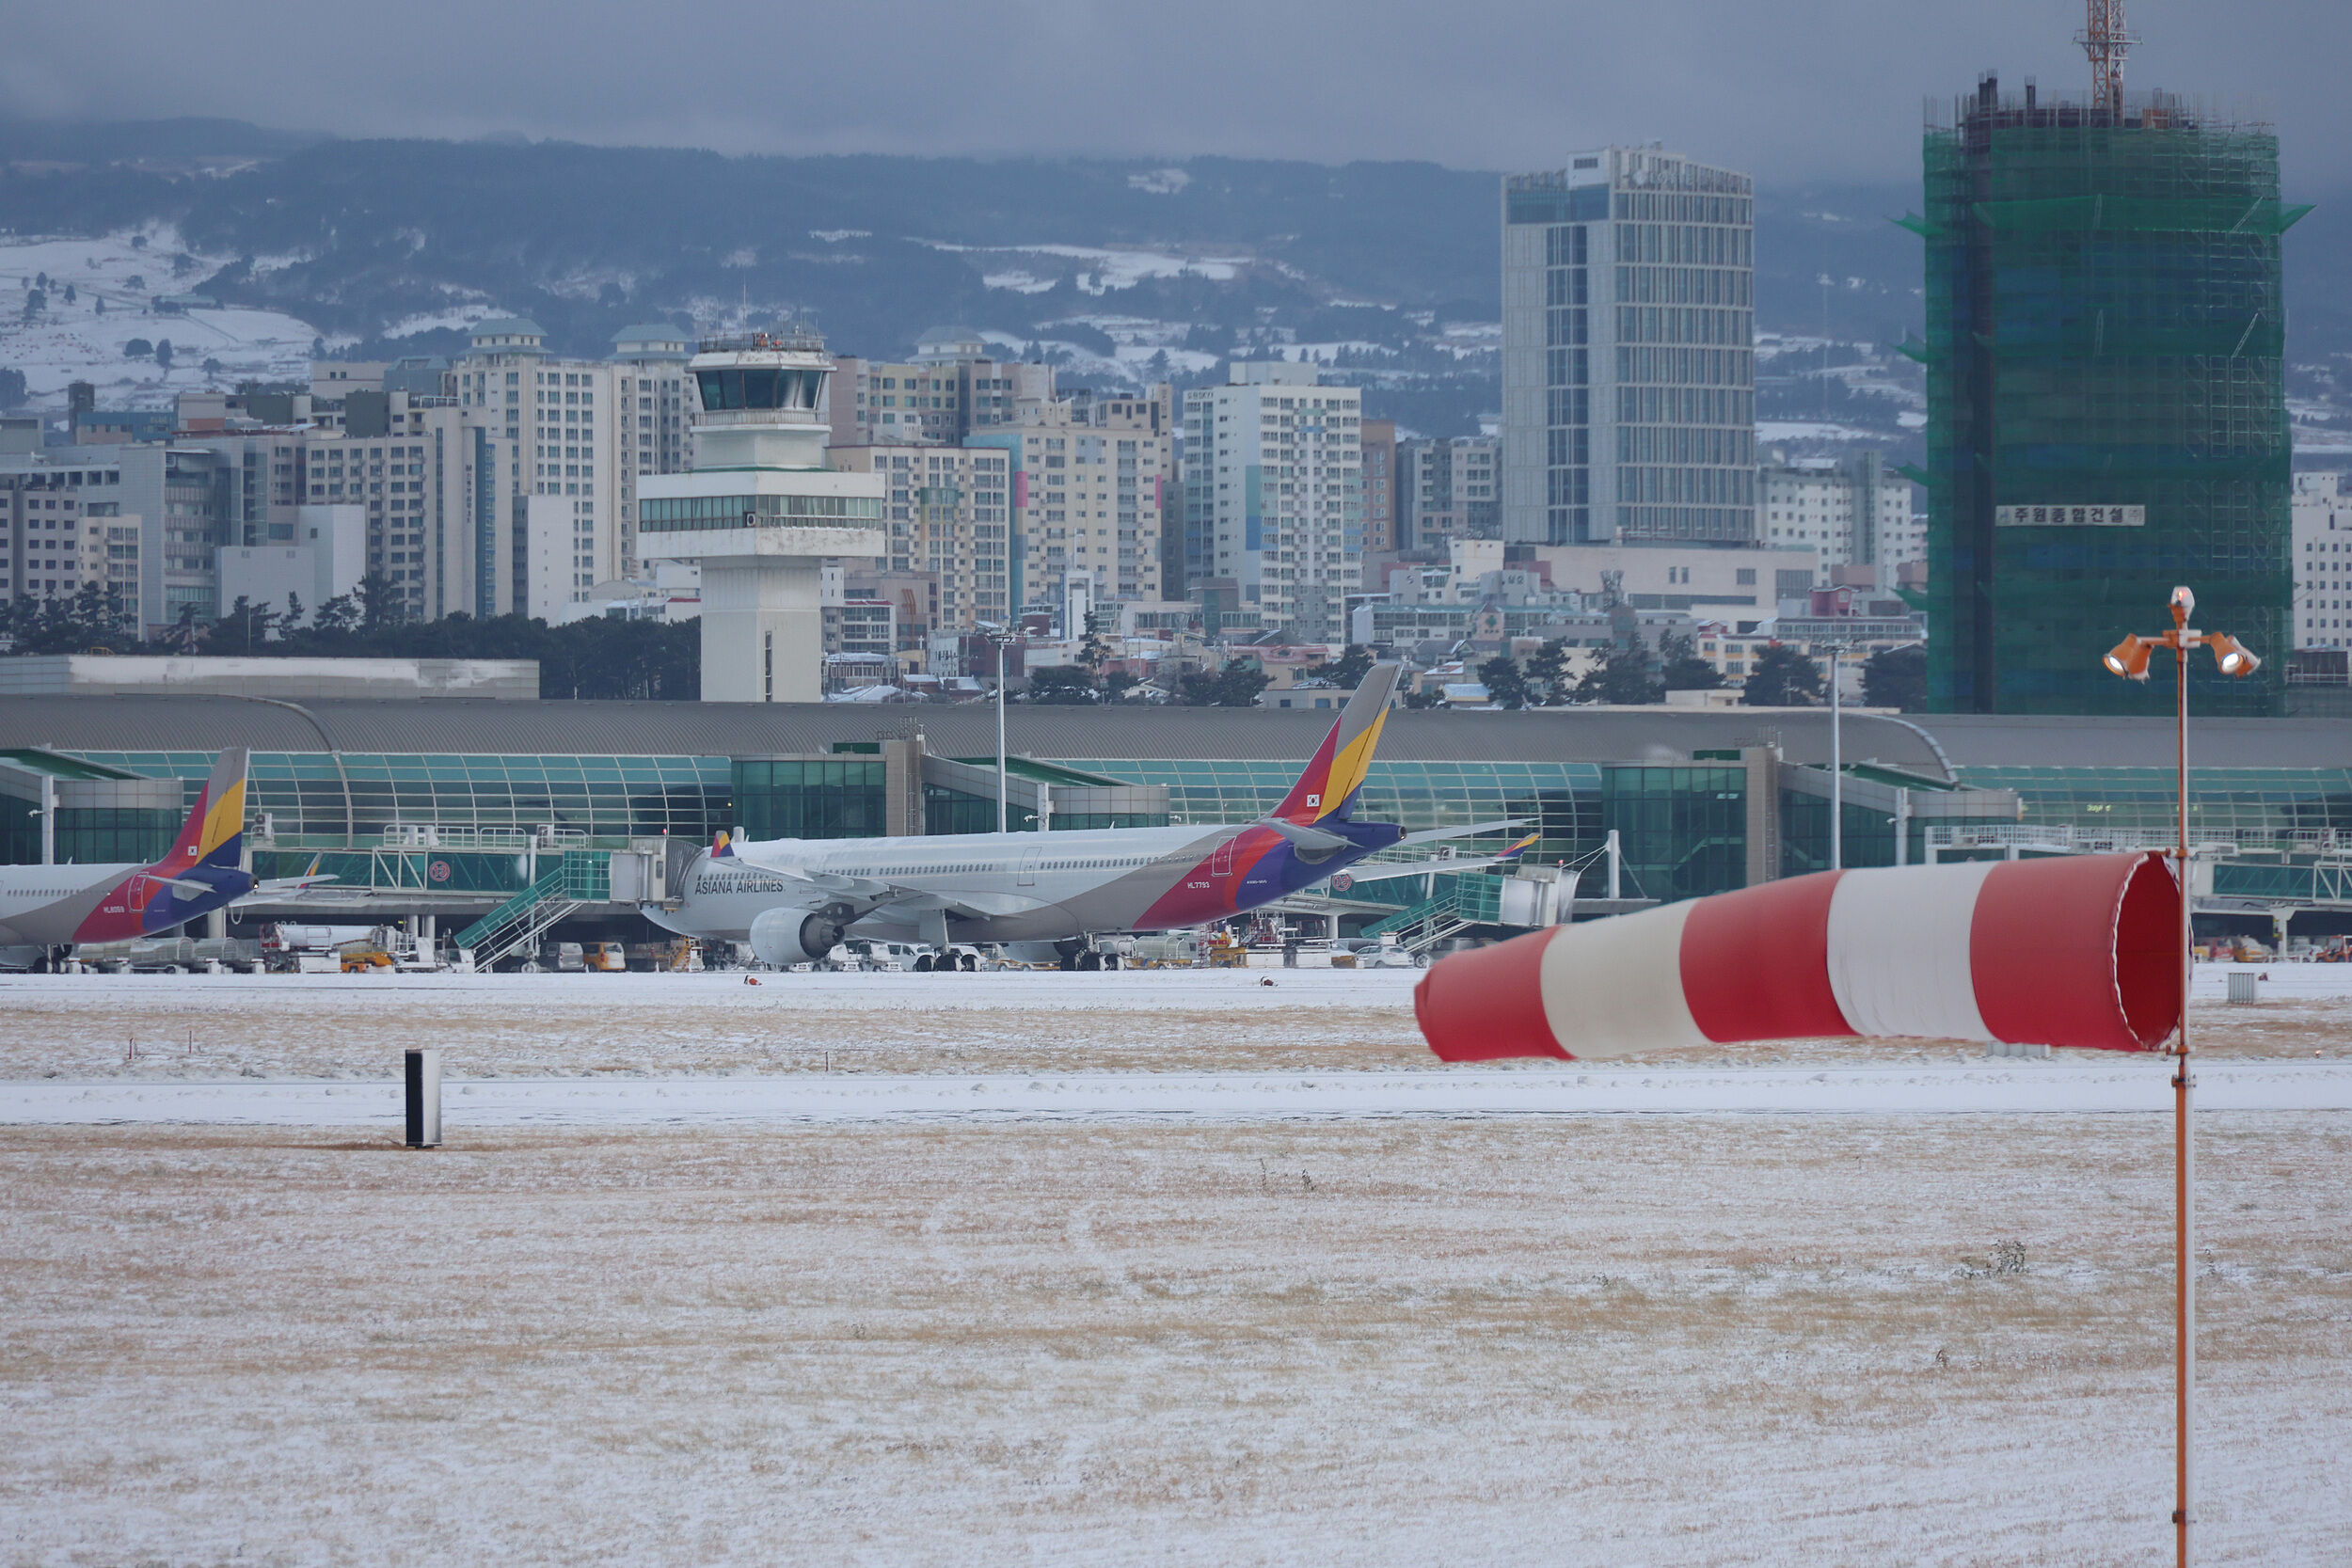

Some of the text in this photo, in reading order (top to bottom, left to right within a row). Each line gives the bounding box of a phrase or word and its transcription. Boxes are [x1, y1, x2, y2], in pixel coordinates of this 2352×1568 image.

[2015, 507, 2123, 523] 주원종합건설
[695, 879, 784, 895] ASIANA AIRLINES
